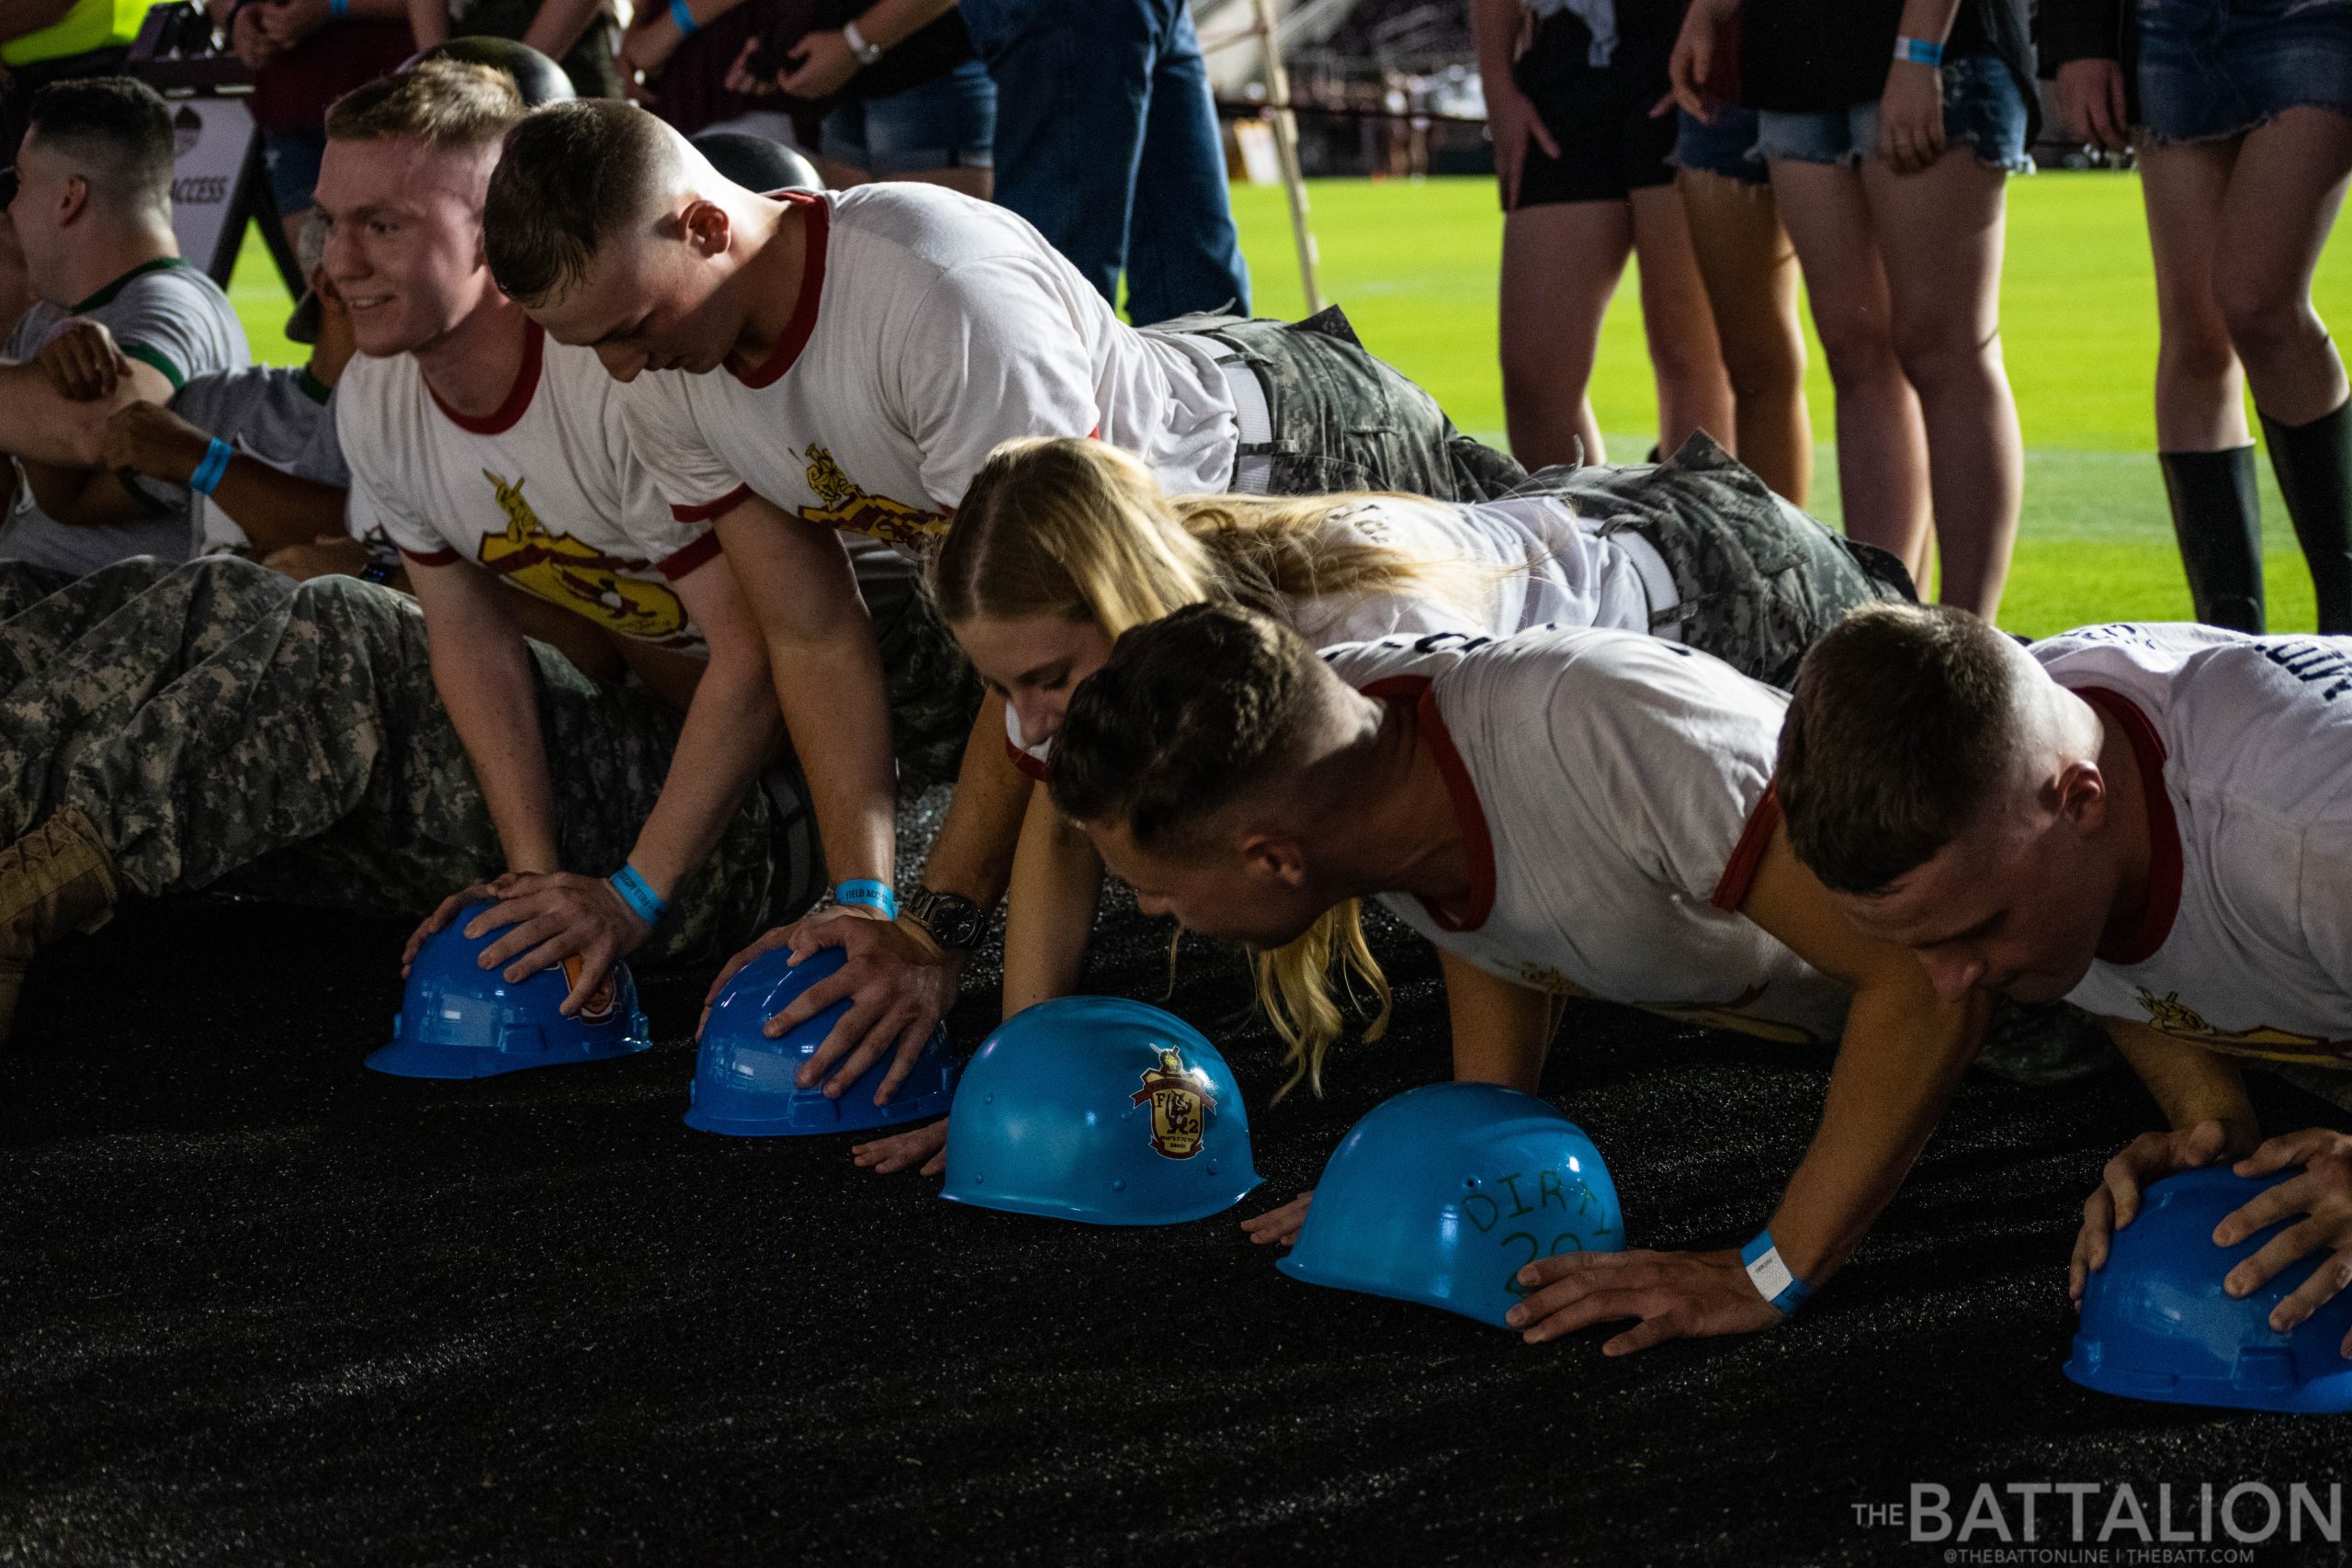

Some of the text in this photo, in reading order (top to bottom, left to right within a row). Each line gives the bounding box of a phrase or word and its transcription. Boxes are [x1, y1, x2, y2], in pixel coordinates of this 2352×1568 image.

[845, 888, 865, 900] FIELD
[1157, 1093, 1166, 1108] F
[1189, 1119, 1199, 1134] 2
